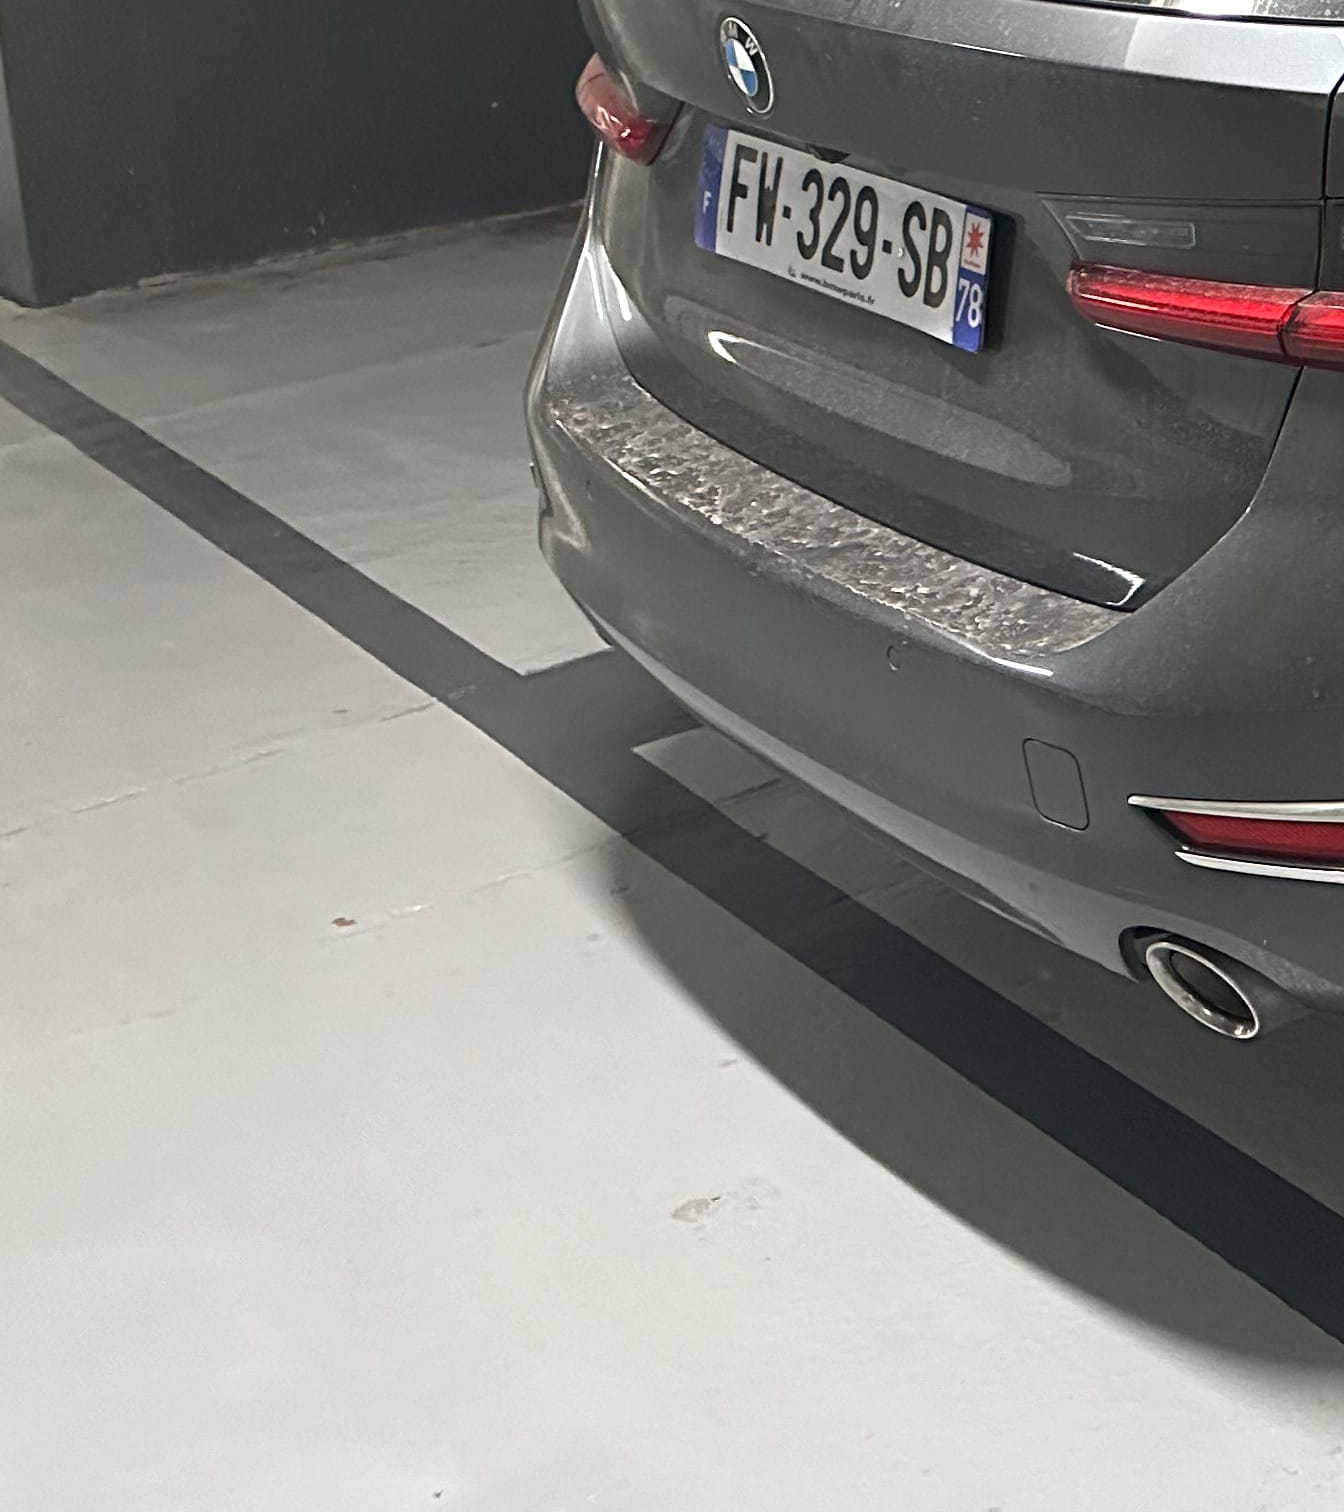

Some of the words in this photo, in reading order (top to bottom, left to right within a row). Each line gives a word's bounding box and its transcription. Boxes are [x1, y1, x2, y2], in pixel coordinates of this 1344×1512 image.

[702, 190, 713, 215] F
[726, 143, 954, 309] FW-329-SB
[955, 277, 984, 328] 78
